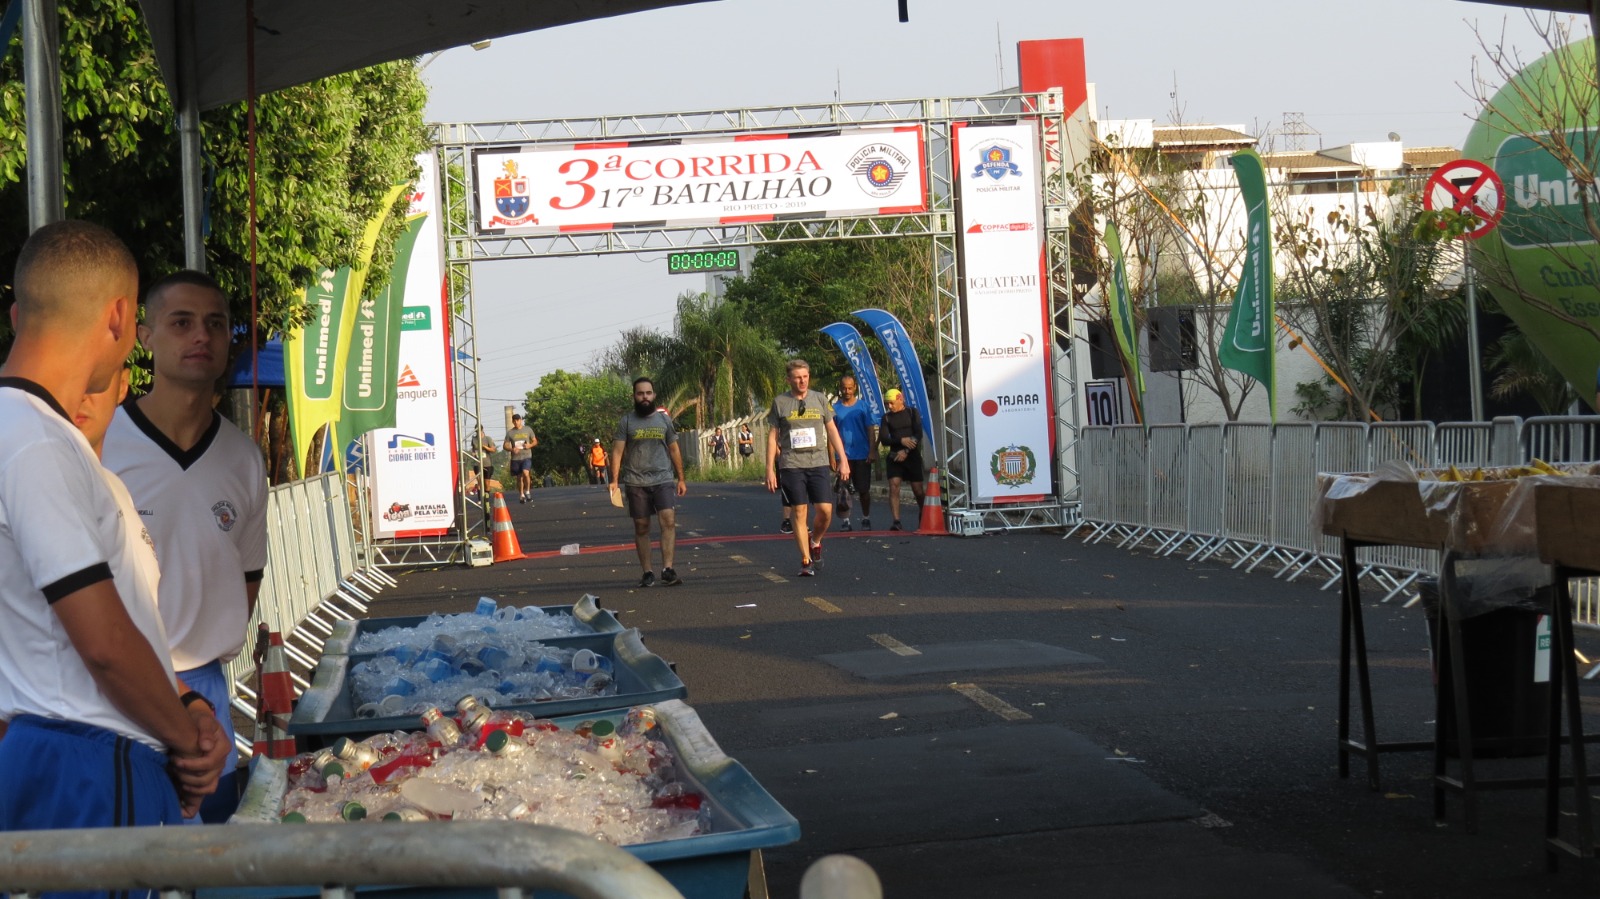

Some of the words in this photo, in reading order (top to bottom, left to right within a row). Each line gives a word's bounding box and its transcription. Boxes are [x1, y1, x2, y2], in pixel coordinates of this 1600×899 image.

[624, 150, 824, 181] CORRIDA
[879, 146, 907, 166] MILITAR
[650, 171, 832, 206] BATALHÃO
[744, 202, 777, 211] PRETO
[970, 275, 1037, 289] IGUATEMI
[1540, 262, 1600, 287] Cuid
[1252, 251, 1261, 336] Unimed
[316, 299, 332, 384] Unimed
[979, 347, 1028, 356] AUDIBEL
[358, 324, 374, 397] Unimed
[997, 394, 1039, 406] TAJARA
[389, 453, 412, 462] CIDADE
